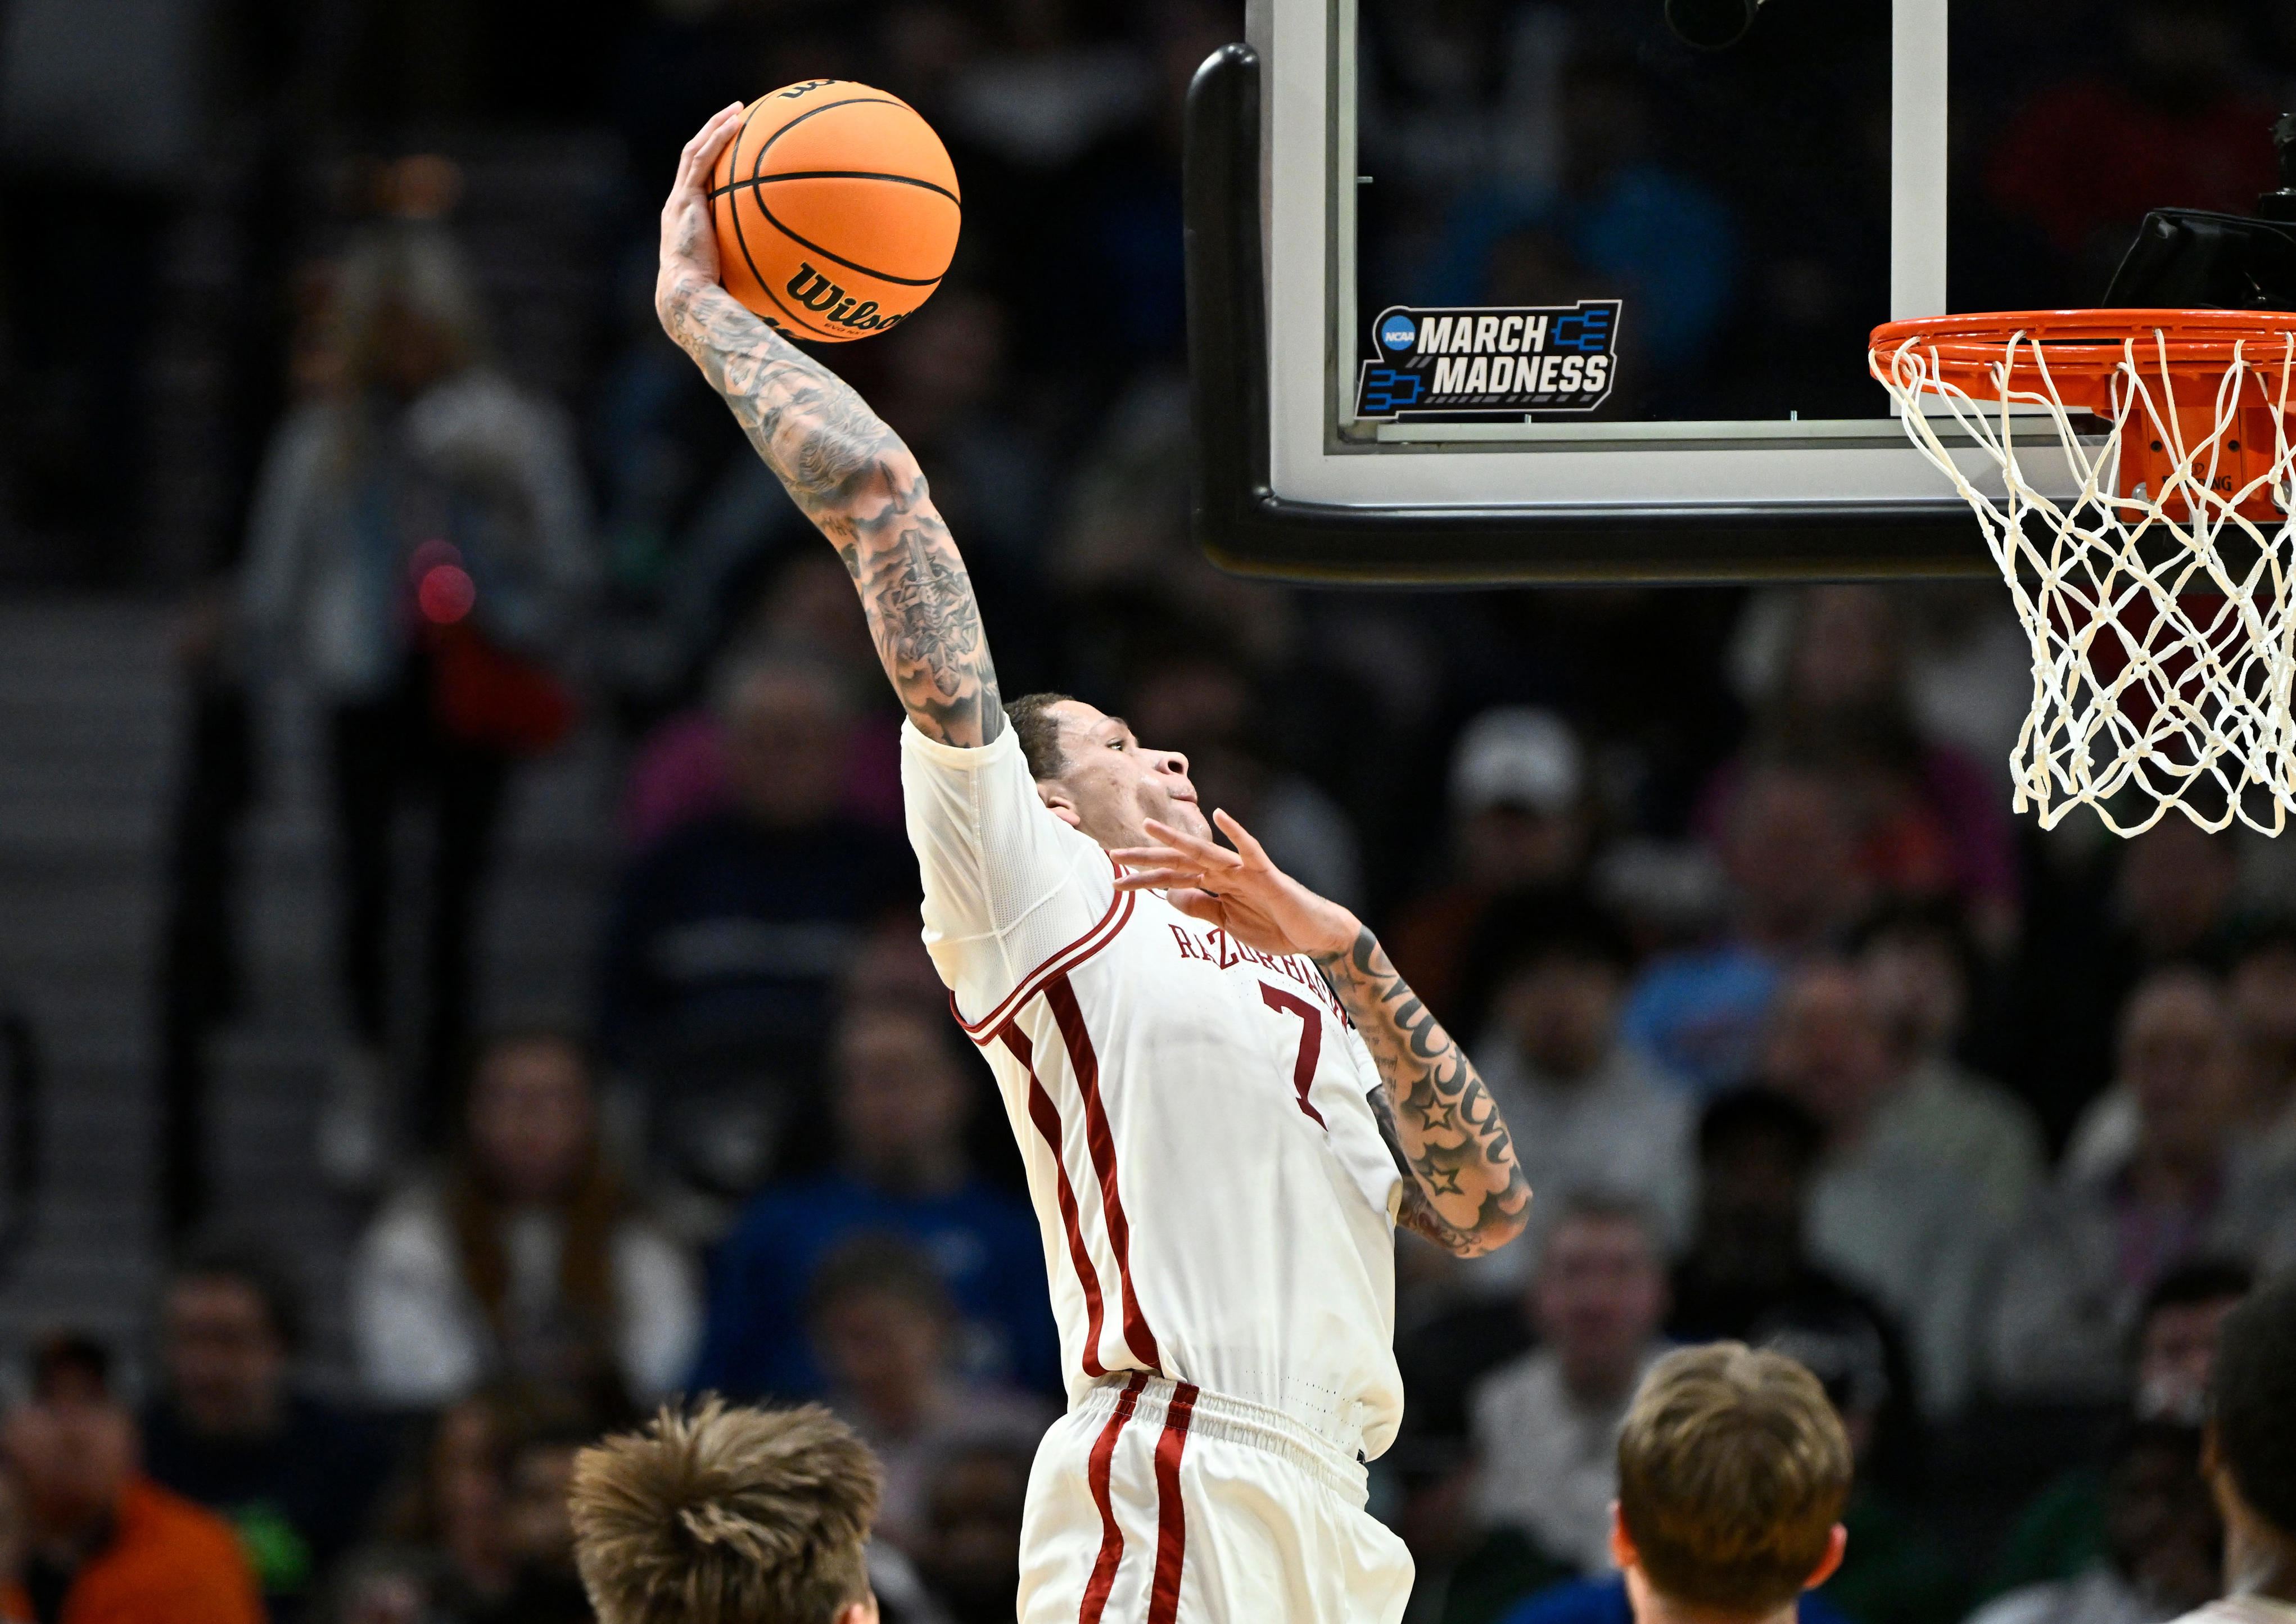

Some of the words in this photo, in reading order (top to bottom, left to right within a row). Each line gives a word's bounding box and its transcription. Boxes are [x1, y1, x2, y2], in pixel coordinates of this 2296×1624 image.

[787, 261, 920, 330] Wilso
[1385, 332, 1414, 341] NCAA
[1417, 316, 1548, 354] MARCH
[1432, 355, 1608, 393] MADNESS
[1258, 979, 1328, 1132] 7
